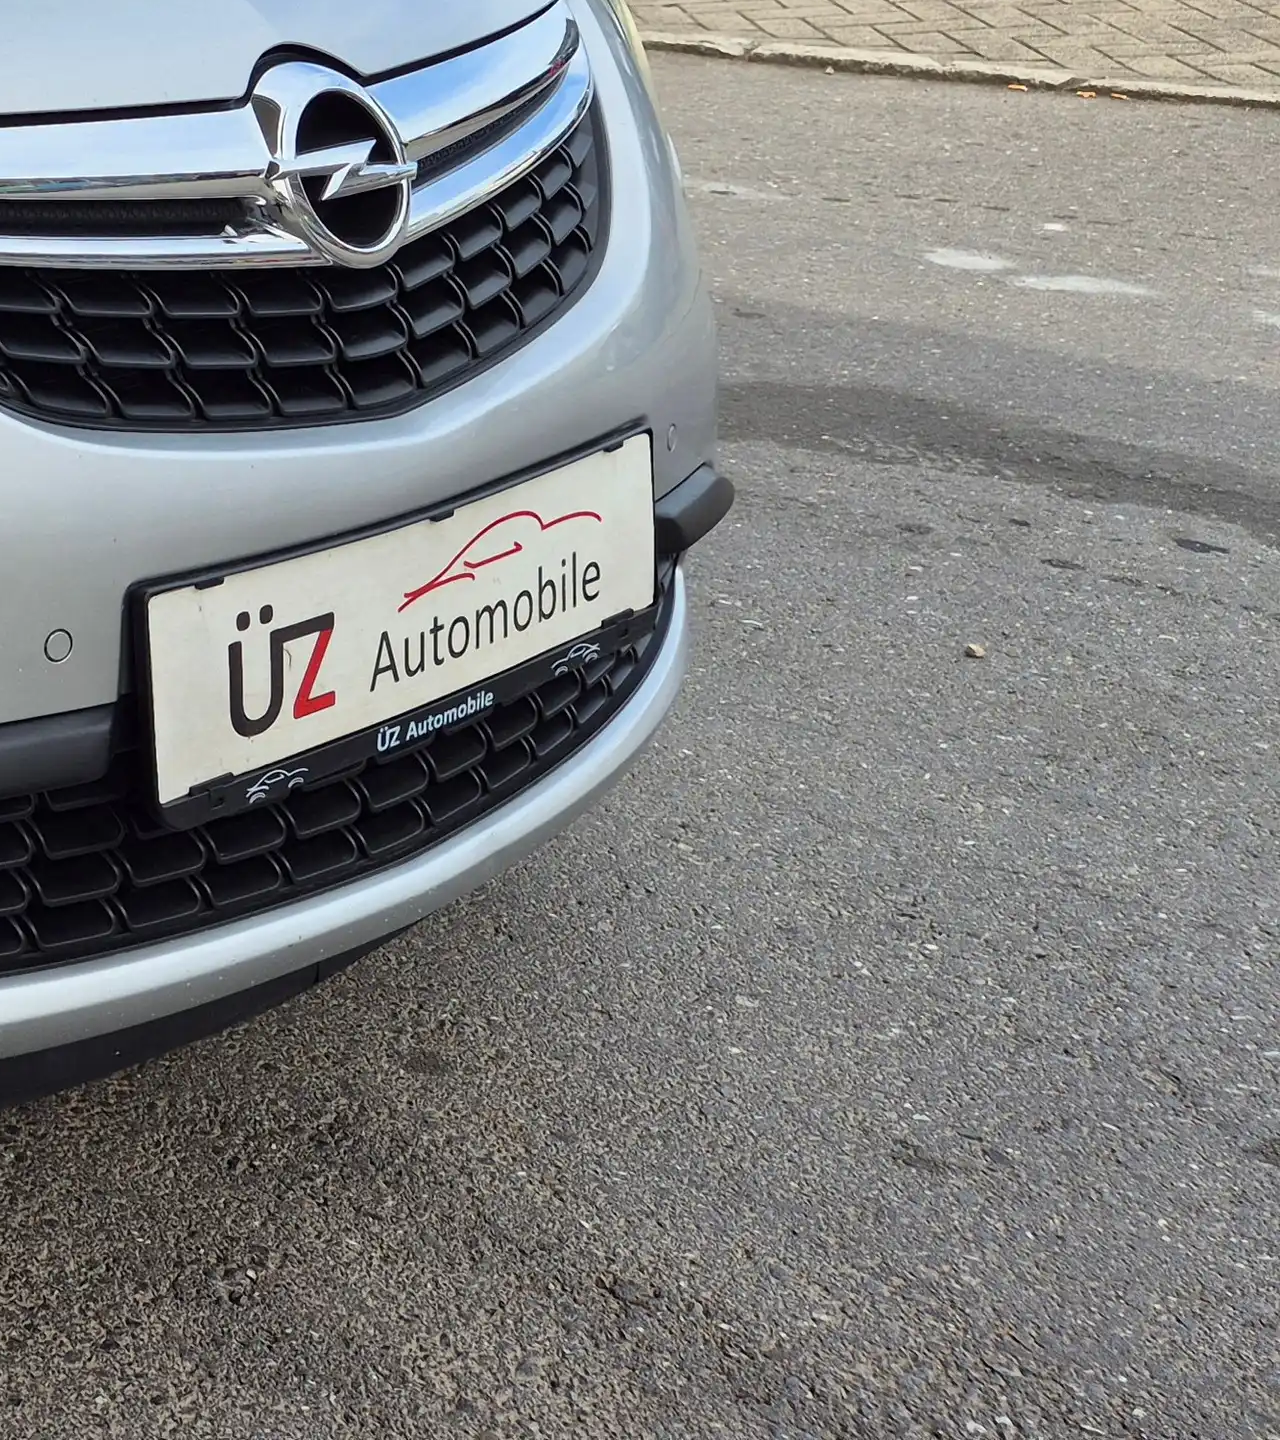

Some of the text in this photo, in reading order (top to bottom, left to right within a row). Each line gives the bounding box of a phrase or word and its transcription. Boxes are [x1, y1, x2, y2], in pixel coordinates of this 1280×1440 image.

[228, 551, 601, 738] ÜZ Automobile
[376, 690, 494, 752] ÜZ Automobile
